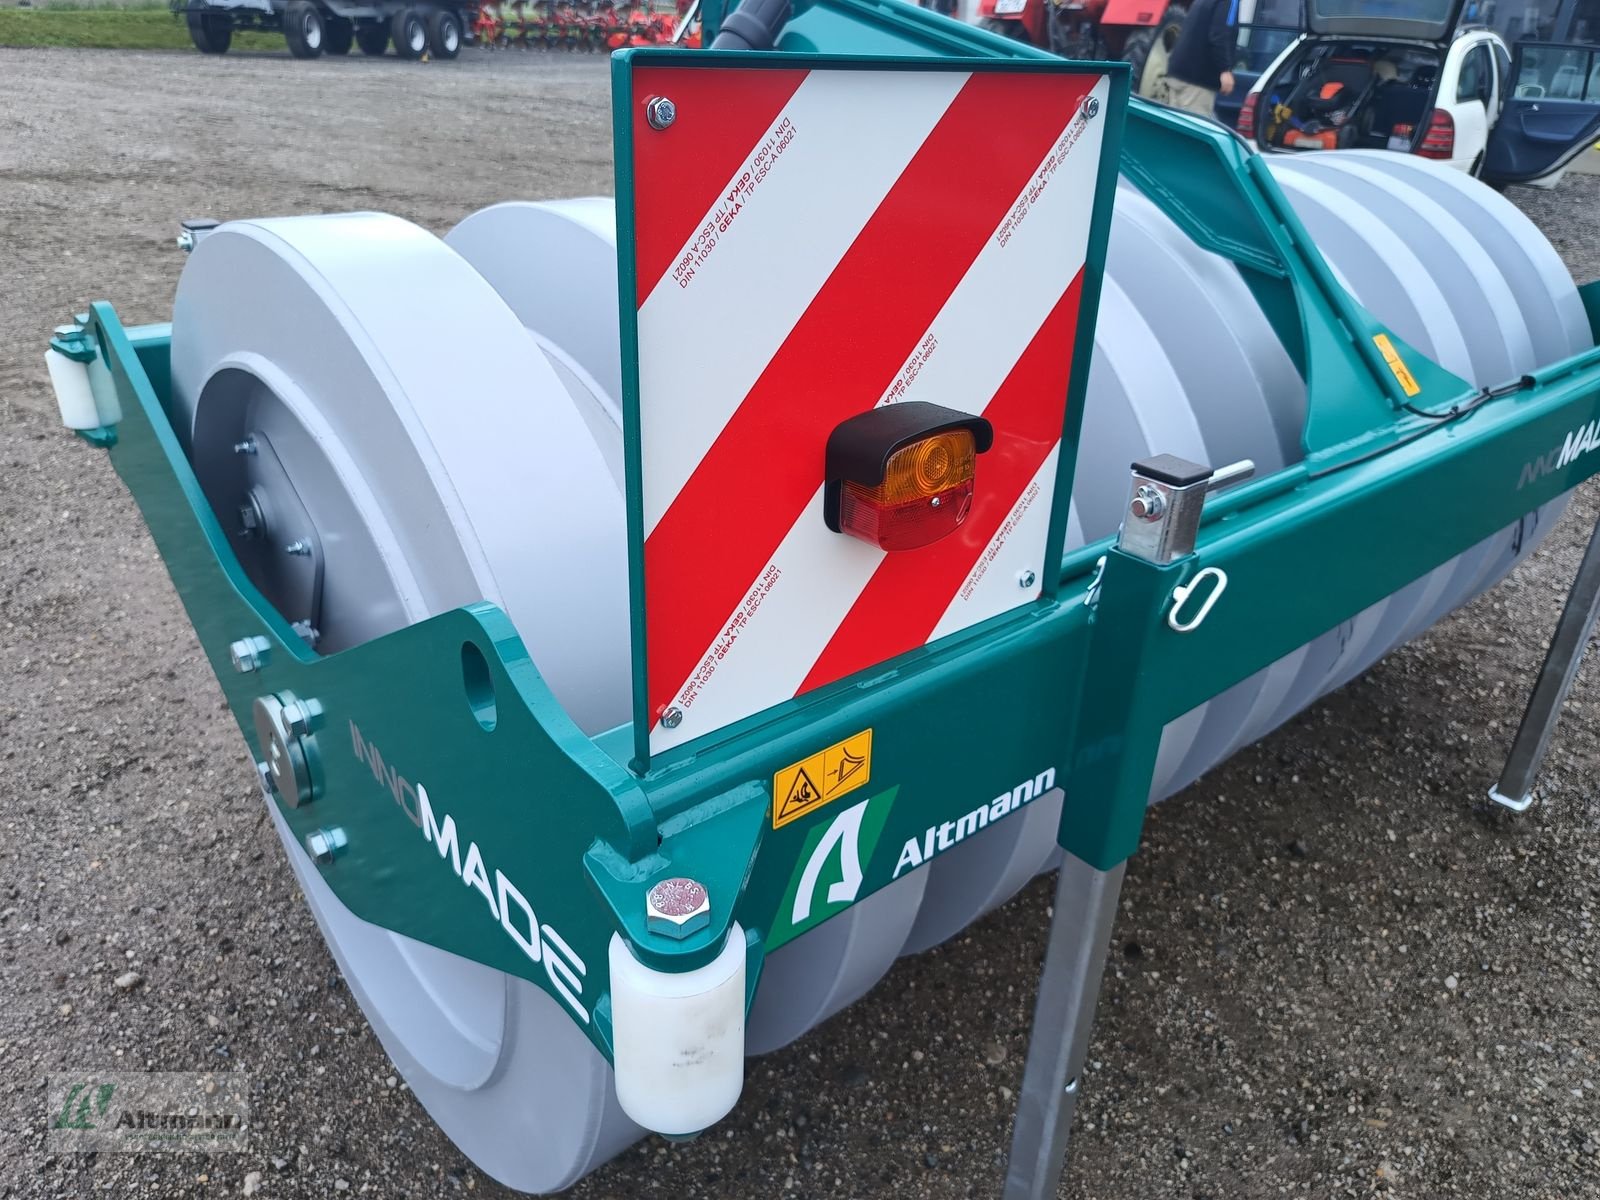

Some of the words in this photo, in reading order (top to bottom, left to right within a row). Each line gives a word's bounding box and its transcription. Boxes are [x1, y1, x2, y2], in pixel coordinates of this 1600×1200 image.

[775, 117, 791, 138] DIN
[754, 138, 776, 167] 11030
[727, 172, 751, 202] GEKA
[680, 268, 696, 288] DIN
[694, 238, 716, 268] 11030
[719, 203, 742, 233] GEKA
[744, 182, 756, 197] TP
[755, 154, 778, 184] ESC-A
[776, 126, 796, 154] 06021
[715, 208, 726, 224] TP
[691, 222, 716, 252] ESC-A
[672, 252, 694, 282] 06021
[922, 333, 934, 350] DIN
[897, 386, 906, 397] TP
[905, 362, 924, 386] ESC-A
[922, 339, 938, 362] 06021
[906, 351, 922, 374] 11030
[884, 379, 902, 404] GEKA
[763, 564, 776, 582] DIN
[746, 582, 764, 606] 11030
[724, 612, 744, 637] GEKA
[684, 692, 698, 708] DIN
[697, 666, 716, 690] 11030
[718, 634, 737, 660] GEKA
[738, 618, 748, 629] TP
[746, 592, 766, 617] ESC-A
[764, 568, 782, 592] 06021
[714, 644, 723, 656] TP
[694, 654, 714, 680] ESC-A
[678, 680, 696, 705] 06021
[892, 766, 1056, 880] Altmann
